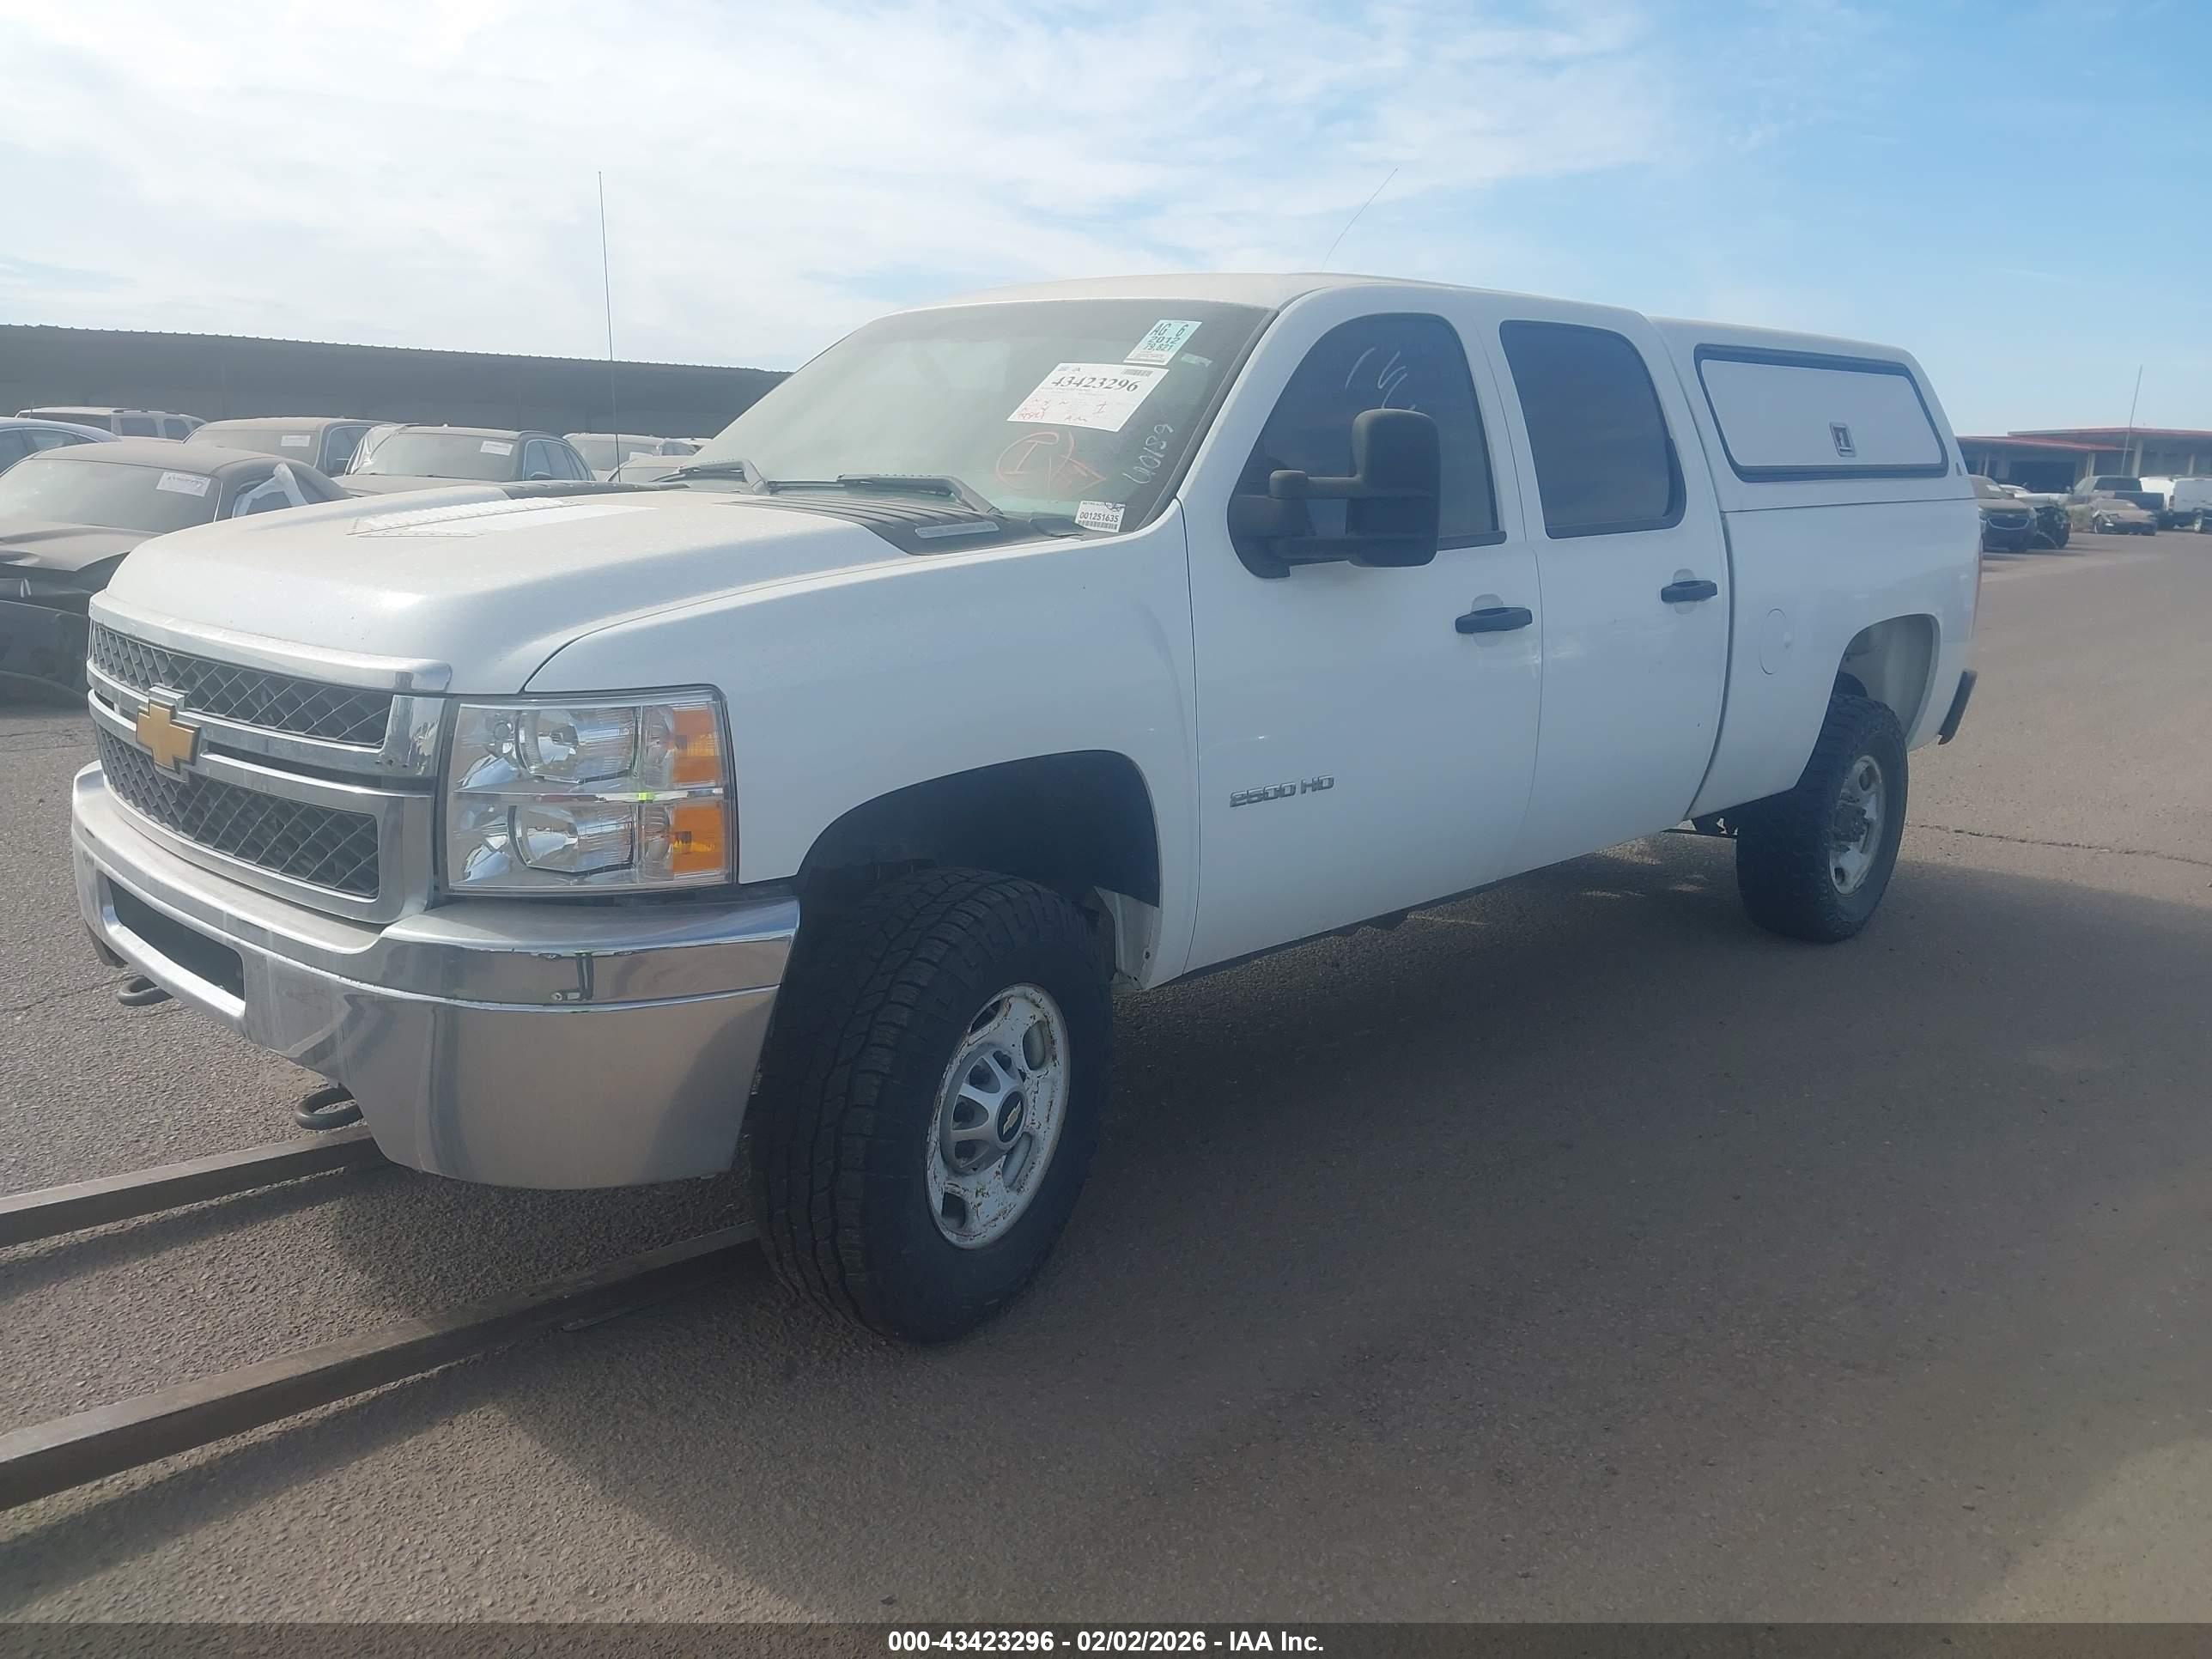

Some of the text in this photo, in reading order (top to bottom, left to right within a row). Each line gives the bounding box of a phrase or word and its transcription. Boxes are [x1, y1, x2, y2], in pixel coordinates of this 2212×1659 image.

[1150, 323, 1188, 337] AG 6
[1148, 336, 1181, 344] 2012
[1051, 375, 1141, 392] 43423296
[1079, 511, 1120, 523] 001251635
[1229, 775, 1334, 807] 2500 HD
